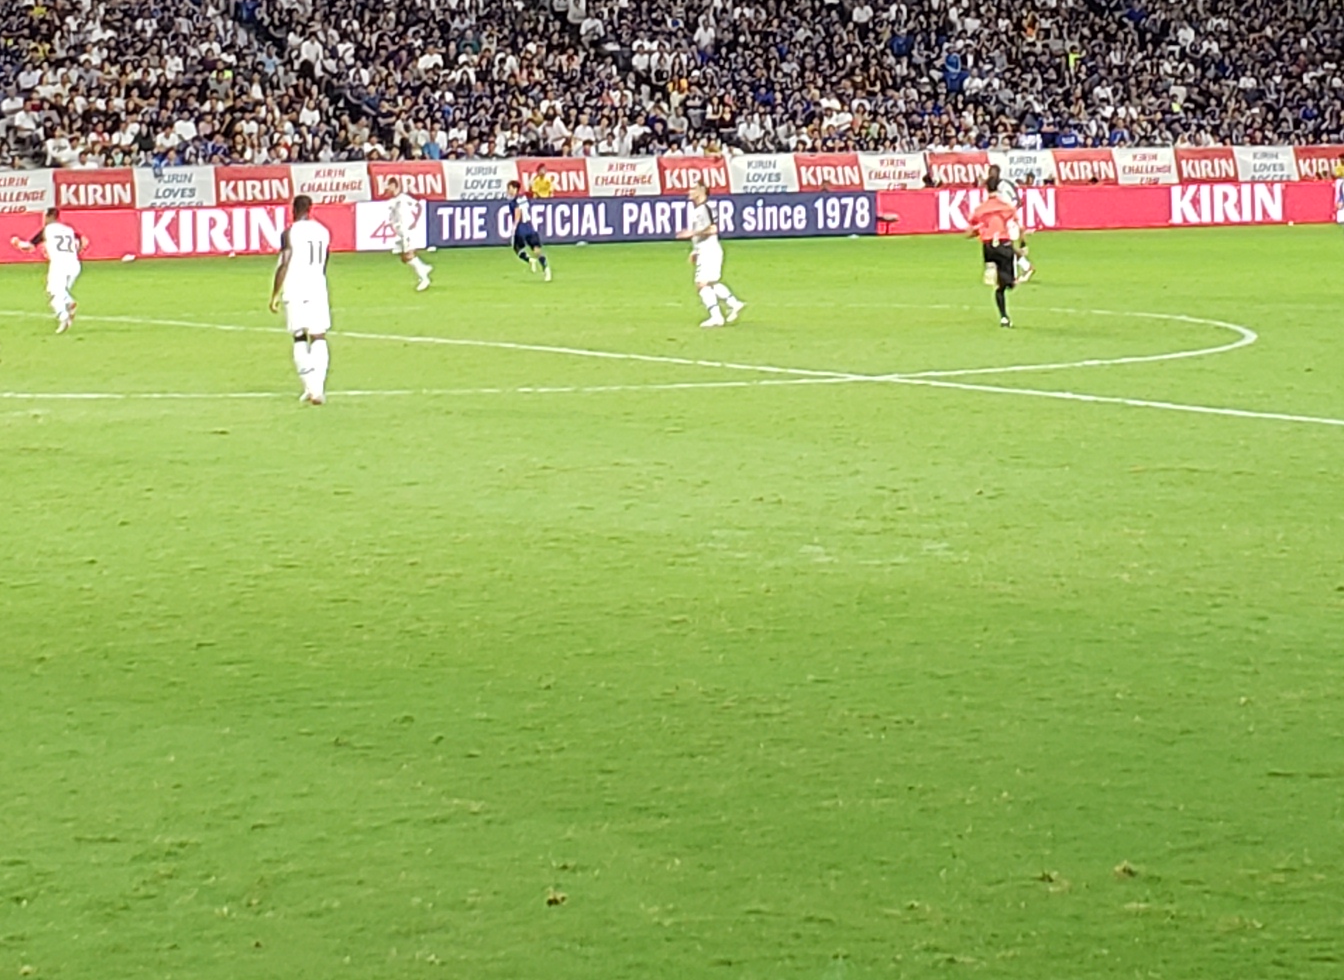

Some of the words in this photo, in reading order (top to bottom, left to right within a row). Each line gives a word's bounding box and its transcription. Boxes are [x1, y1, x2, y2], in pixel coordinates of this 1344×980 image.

[314, 169, 346, 179] KIRIN
[465, 165, 498, 176] KIRIN
[747, 159, 776, 170] KIRIN
[932, 163, 990, 185] KIRIN
[1058, 160, 1116, 181] KIRIN
[1180, 158, 1235, 178] KIRIN
[1253, 162, 1285, 173] LOVES
[300, 180, 362, 193] CHALLENGE
[464, 179, 502, 190] LOVES
[595, 174, 652, 186] CHALLENGE
[664, 167, 726, 189] KIRIN
[746, 173, 782, 183] LOVES
[800, 165, 861, 188] KIRIN
[60, 183, 131, 206] KIRIN
[154, 187, 196, 199] LOVES
[219, 177, 290, 202] KIRIN
[1170, 183, 1283, 224] KIRIN
[437, 206, 487, 240] THE
[743, 198, 806, 232] since
[814, 196, 870, 229] 1978
[140, 206, 286, 255] KIRIN
[306, 240, 323, 265] 11
